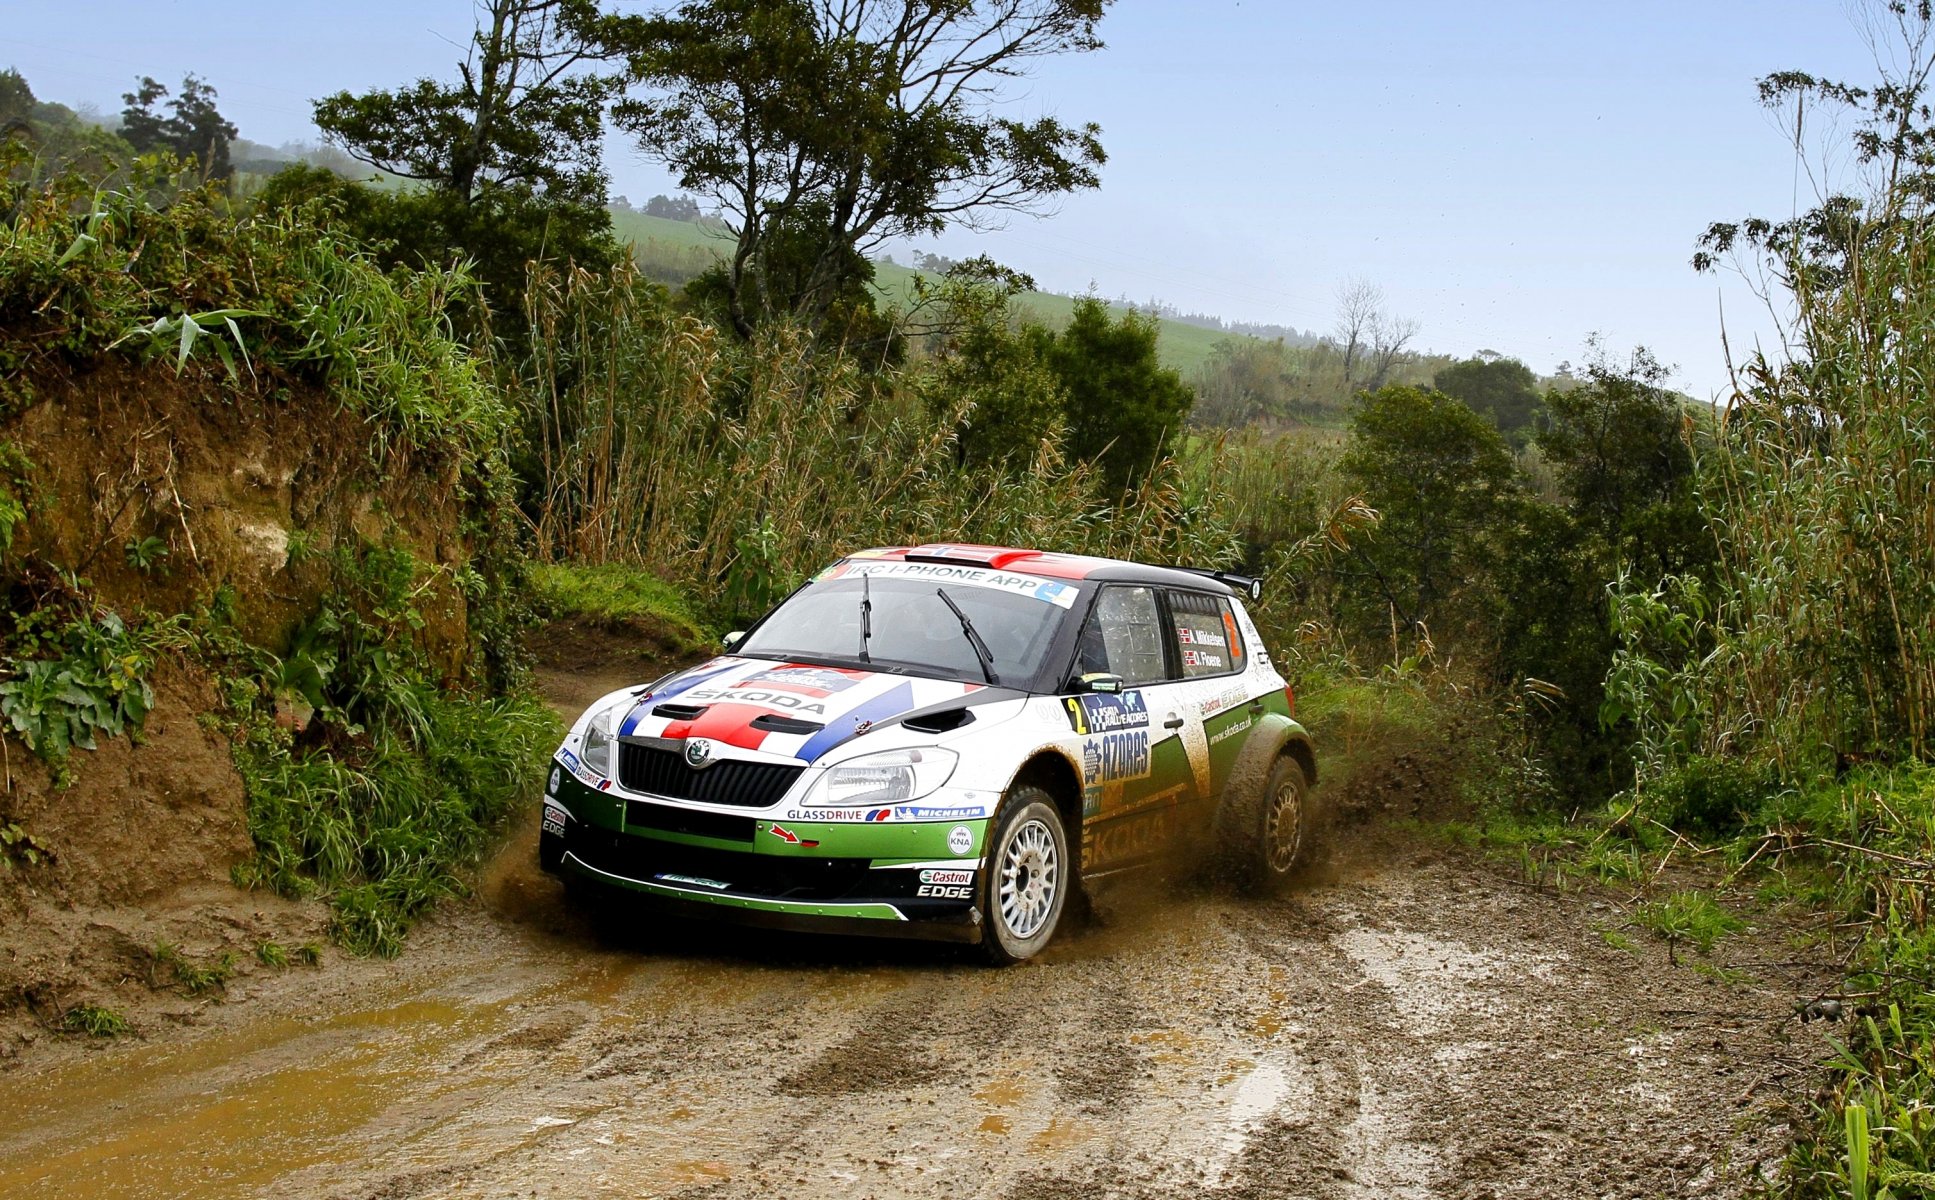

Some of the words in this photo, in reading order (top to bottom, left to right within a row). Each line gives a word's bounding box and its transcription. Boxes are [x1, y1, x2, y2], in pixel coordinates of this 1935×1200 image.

[847, 564, 883, 576] IRC
[888, 564, 986, 581] I-PHONE
[986, 574, 1038, 591] APP
[1223, 610, 1241, 657] 2
[1067, 697, 1087, 735] 2
[1103, 730, 1148, 781] AZORES
[787, 809, 862, 820] GLASSDRIVE
[917, 807, 982, 817] MICHELIN
[542, 819, 566, 838] EDGE
[950, 838, 970, 846] KNA
[932, 871, 970, 884] Castrol
[916, 885, 974, 899] EDGE
